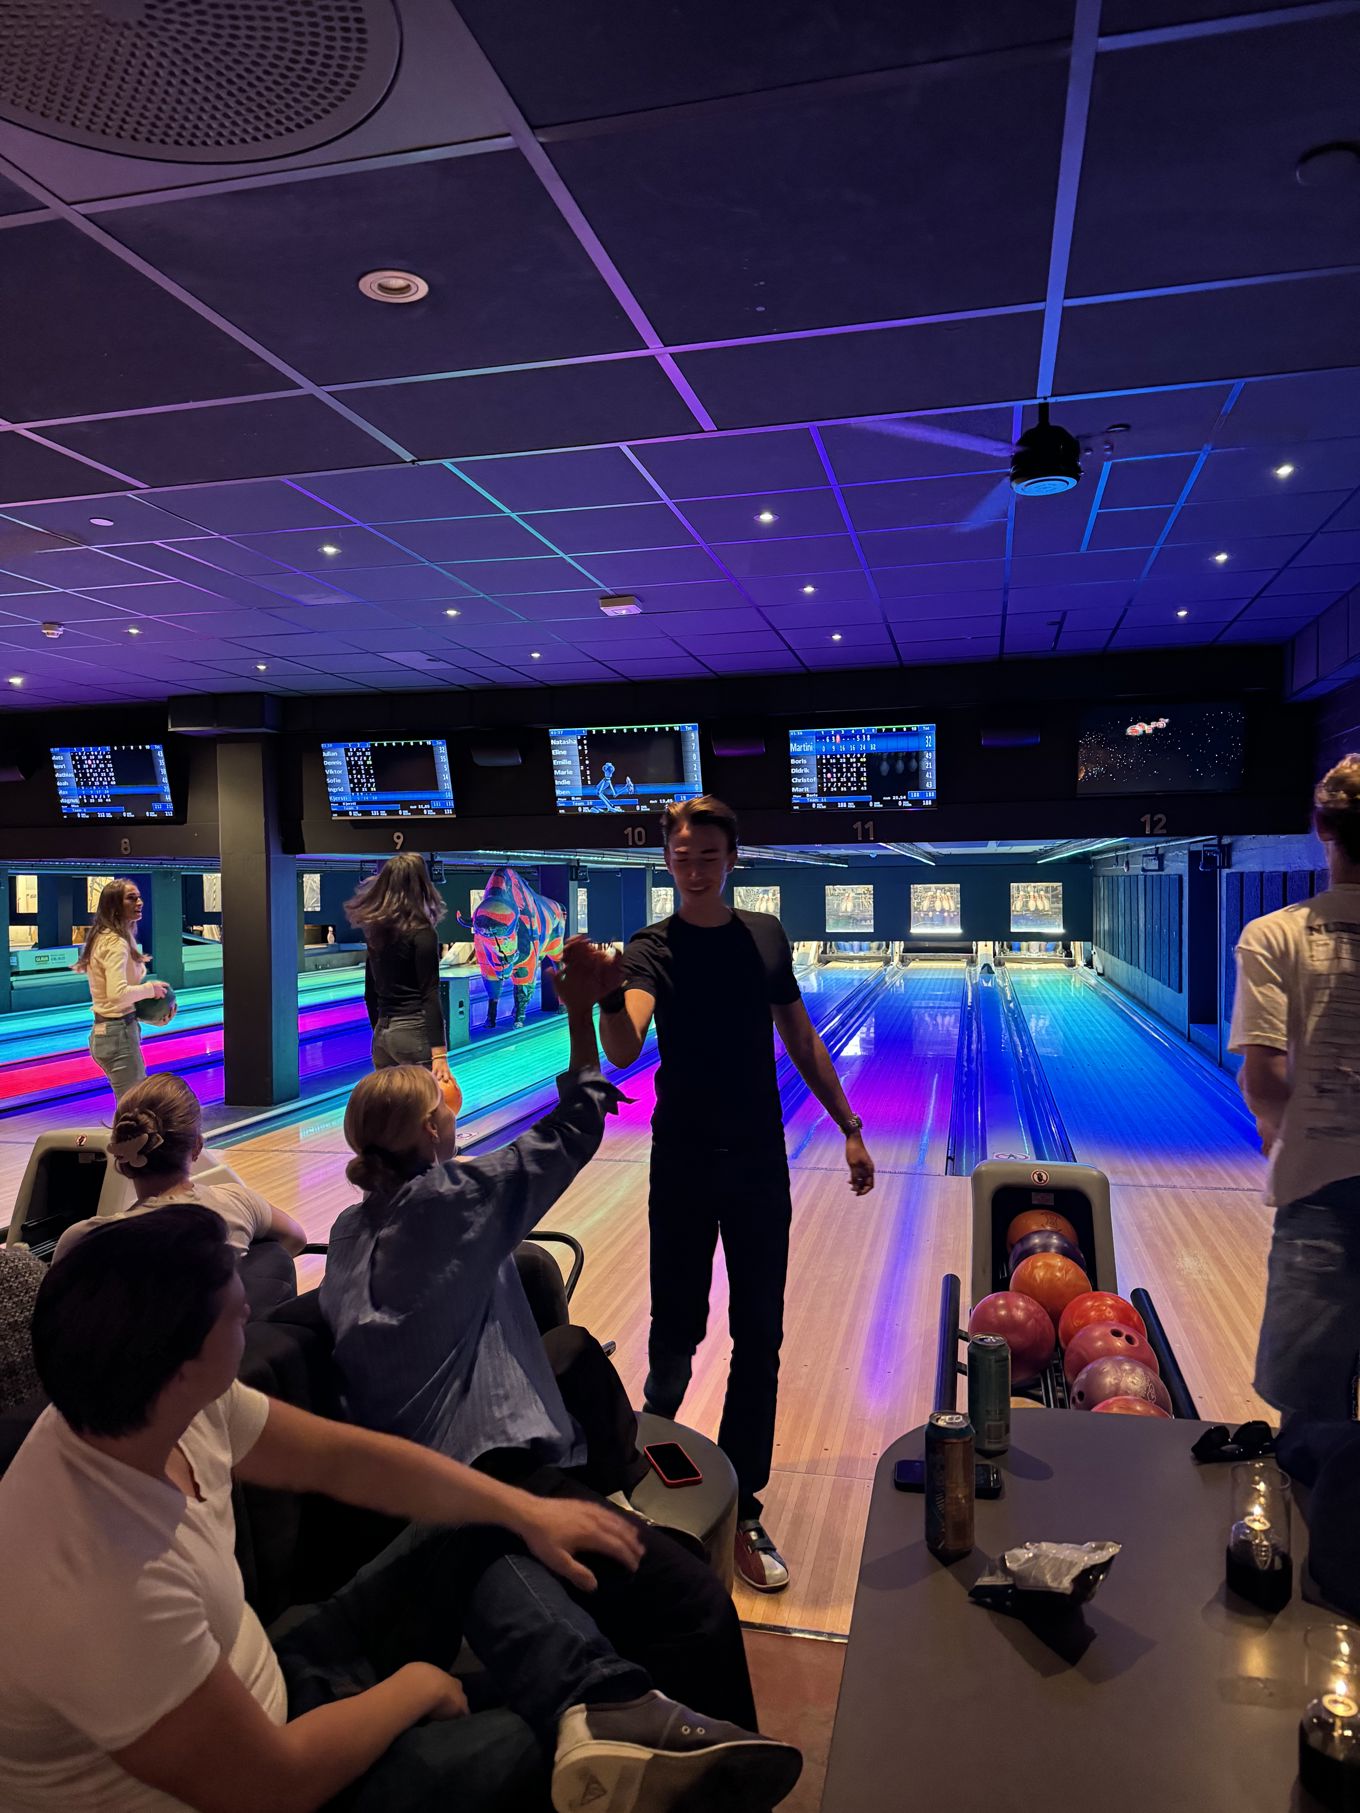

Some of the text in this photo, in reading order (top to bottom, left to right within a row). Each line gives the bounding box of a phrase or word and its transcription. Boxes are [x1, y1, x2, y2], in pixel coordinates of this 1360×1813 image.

[790, 742, 813, 752] Martini
[926, 736, 932, 748] 32
[852, 820, 874, 840] 11
[1140, 814, 1167, 834] 12
[394, 832, 404, 850] 9
[624, 827, 646, 846] 10
[121, 838, 130, 854] 8
